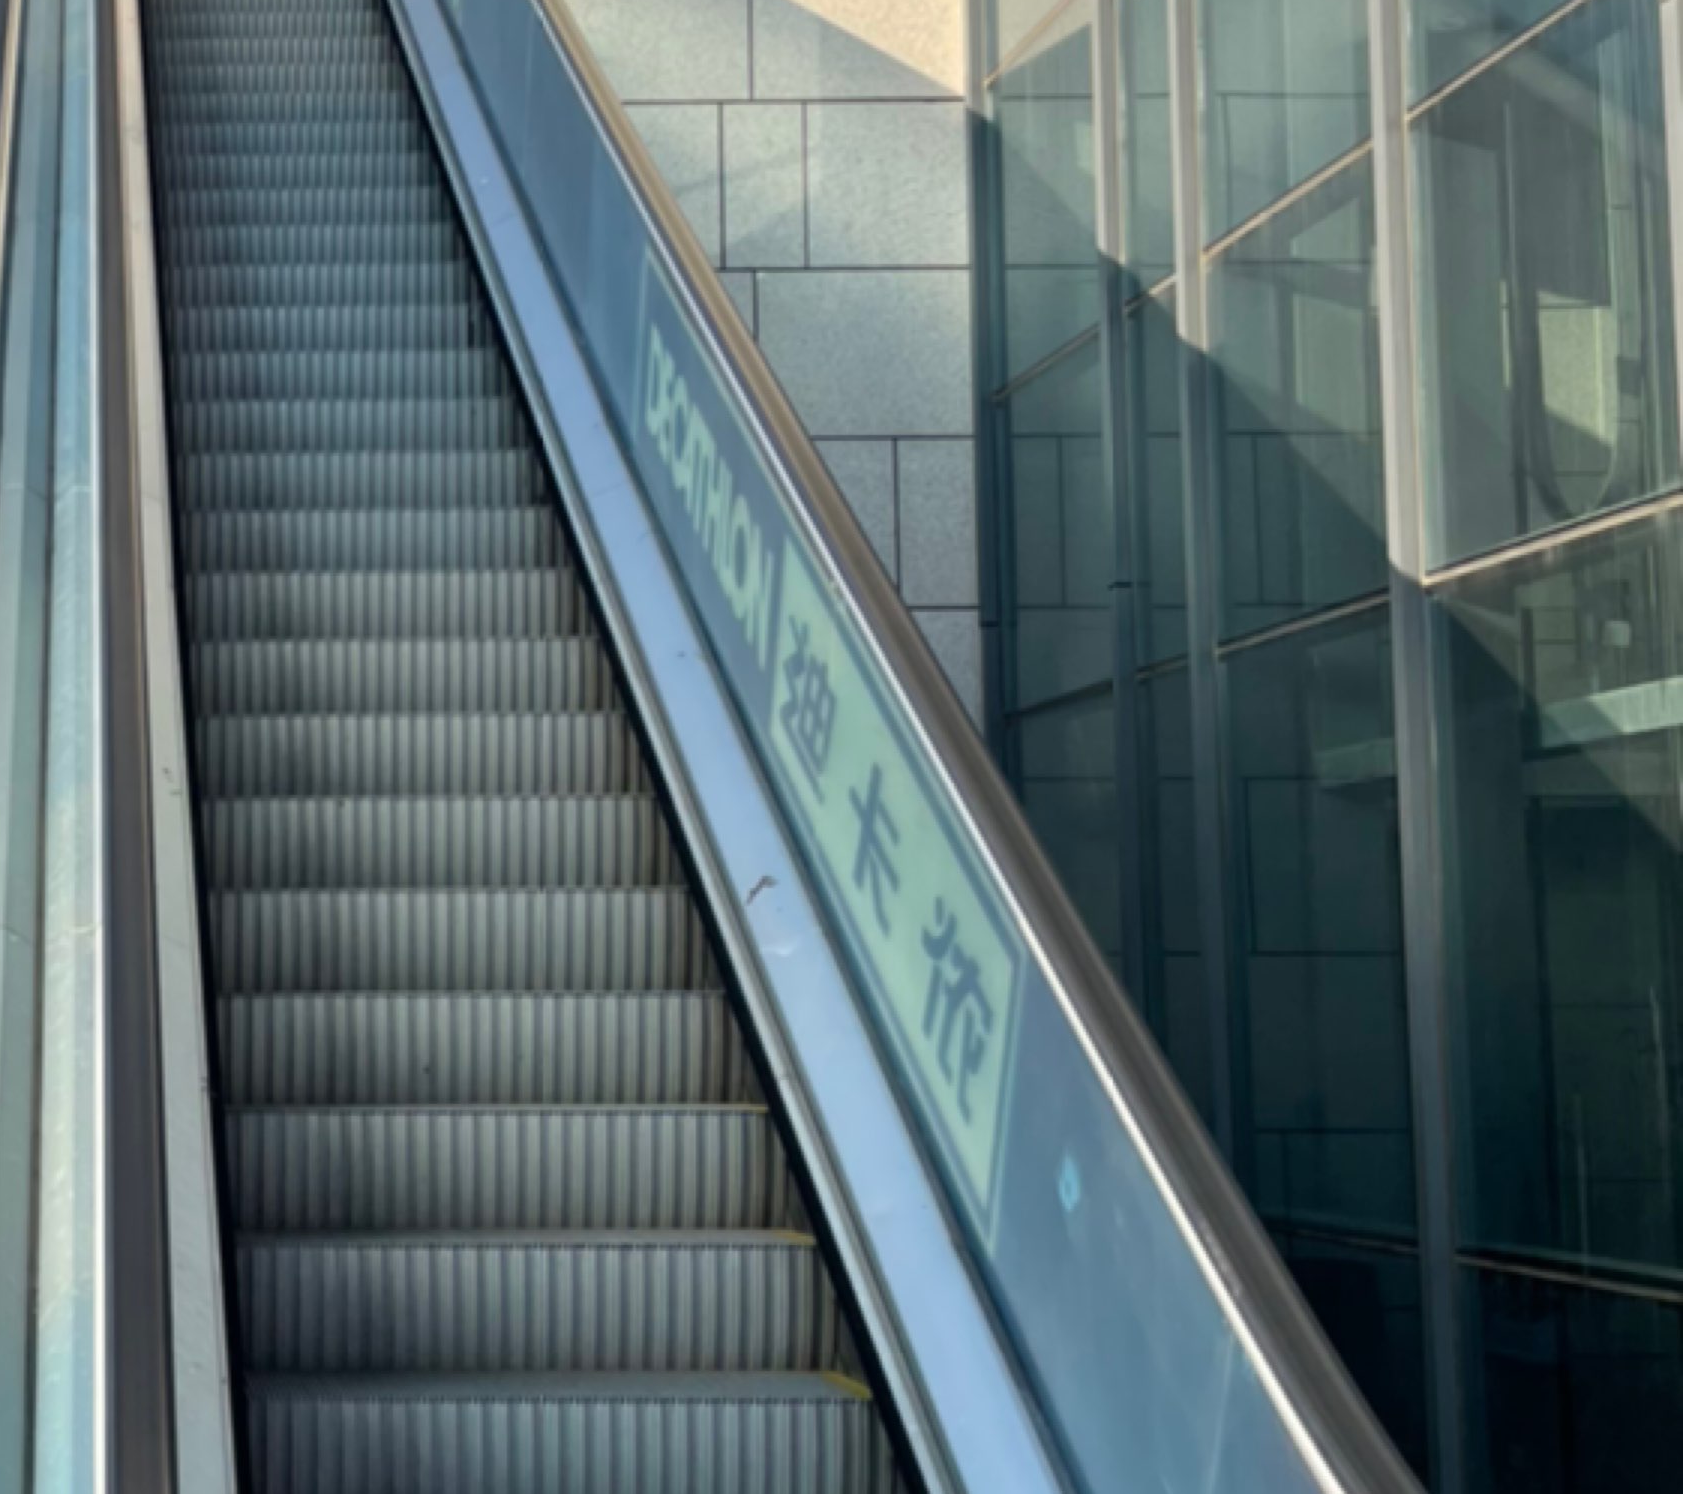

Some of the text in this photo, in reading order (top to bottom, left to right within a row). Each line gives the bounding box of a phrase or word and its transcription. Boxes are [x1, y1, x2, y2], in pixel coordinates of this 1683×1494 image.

[645, 323, 775, 671] DECATHLON
[780, 613, 993, 1127] 迪卡侬
